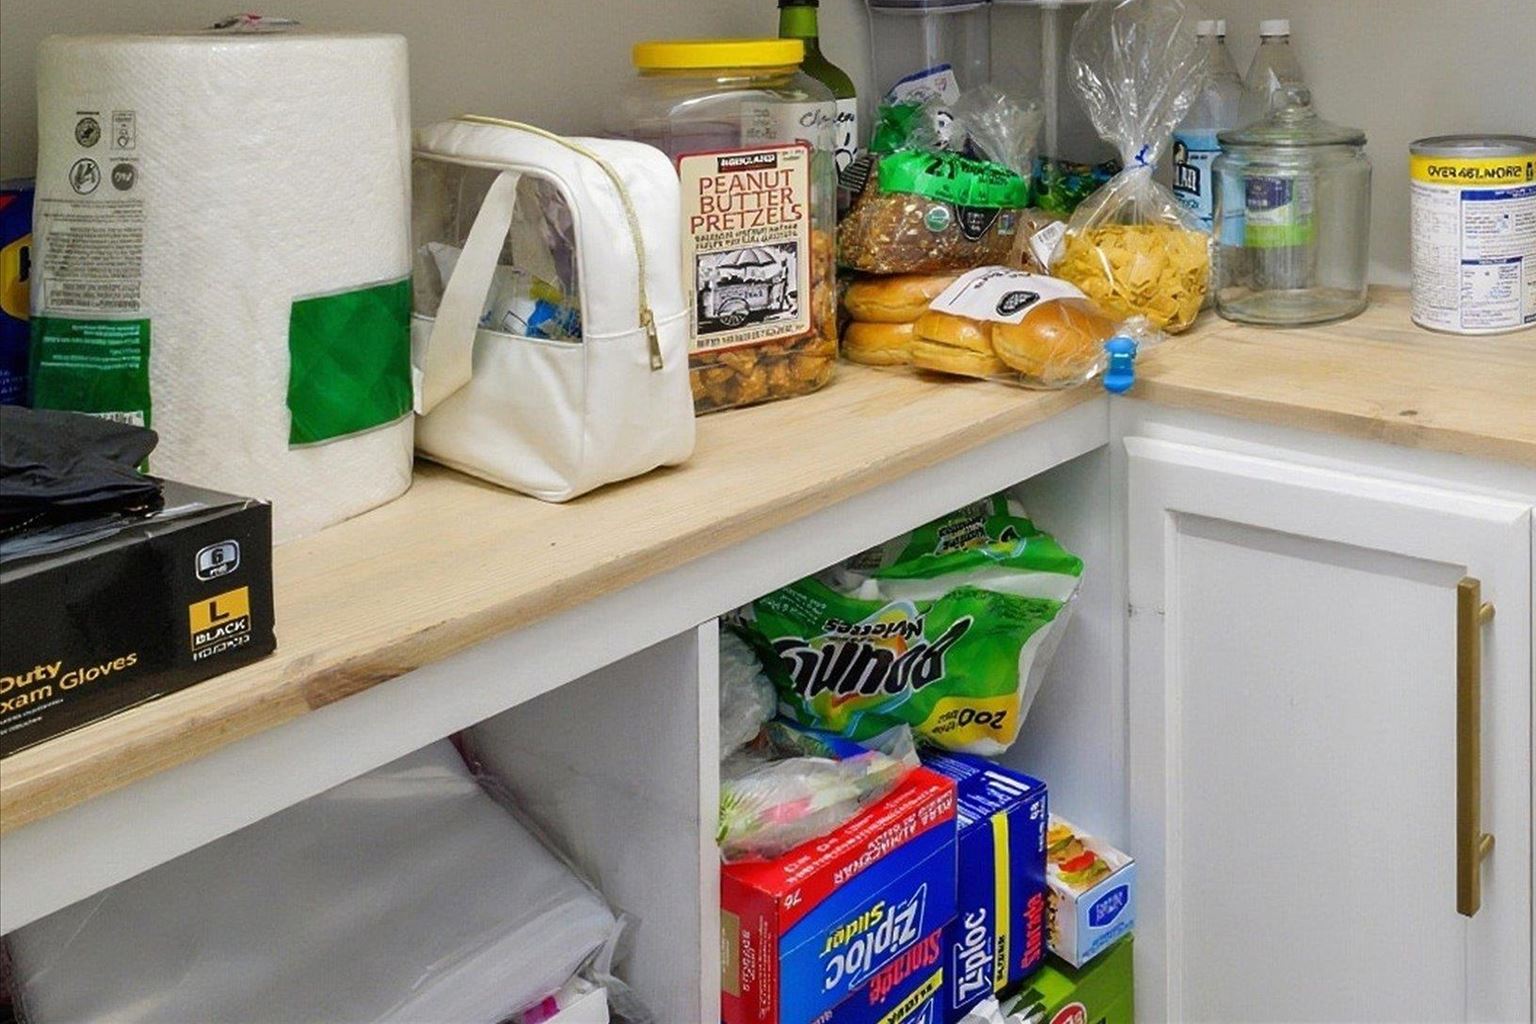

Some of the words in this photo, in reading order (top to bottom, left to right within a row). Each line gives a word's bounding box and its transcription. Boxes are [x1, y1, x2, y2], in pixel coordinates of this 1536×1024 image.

[699, 169, 795, 195] PEANUT
[1427, 164, 1457, 178] OVER
[700, 187, 794, 215] BUTTER
[690, 204, 803, 235] PRETZELS
[210, 547, 224, 565] 6
[208, 600, 231, 623] L
[195, 618, 246, 646] BLACK
[0, 659, 62, 695] Duty
[0, 685, 53, 715] xam
[59, 652, 138, 691] Gloves
[957, 706, 1009, 731] 200
[821, 900, 886, 955] Slider
[1020, 892, 1044, 970] Storage
[825, 897, 919, 992] Ziploc
[958, 906, 994, 1003] Ziploc
[868, 928, 942, 1005] Storage
